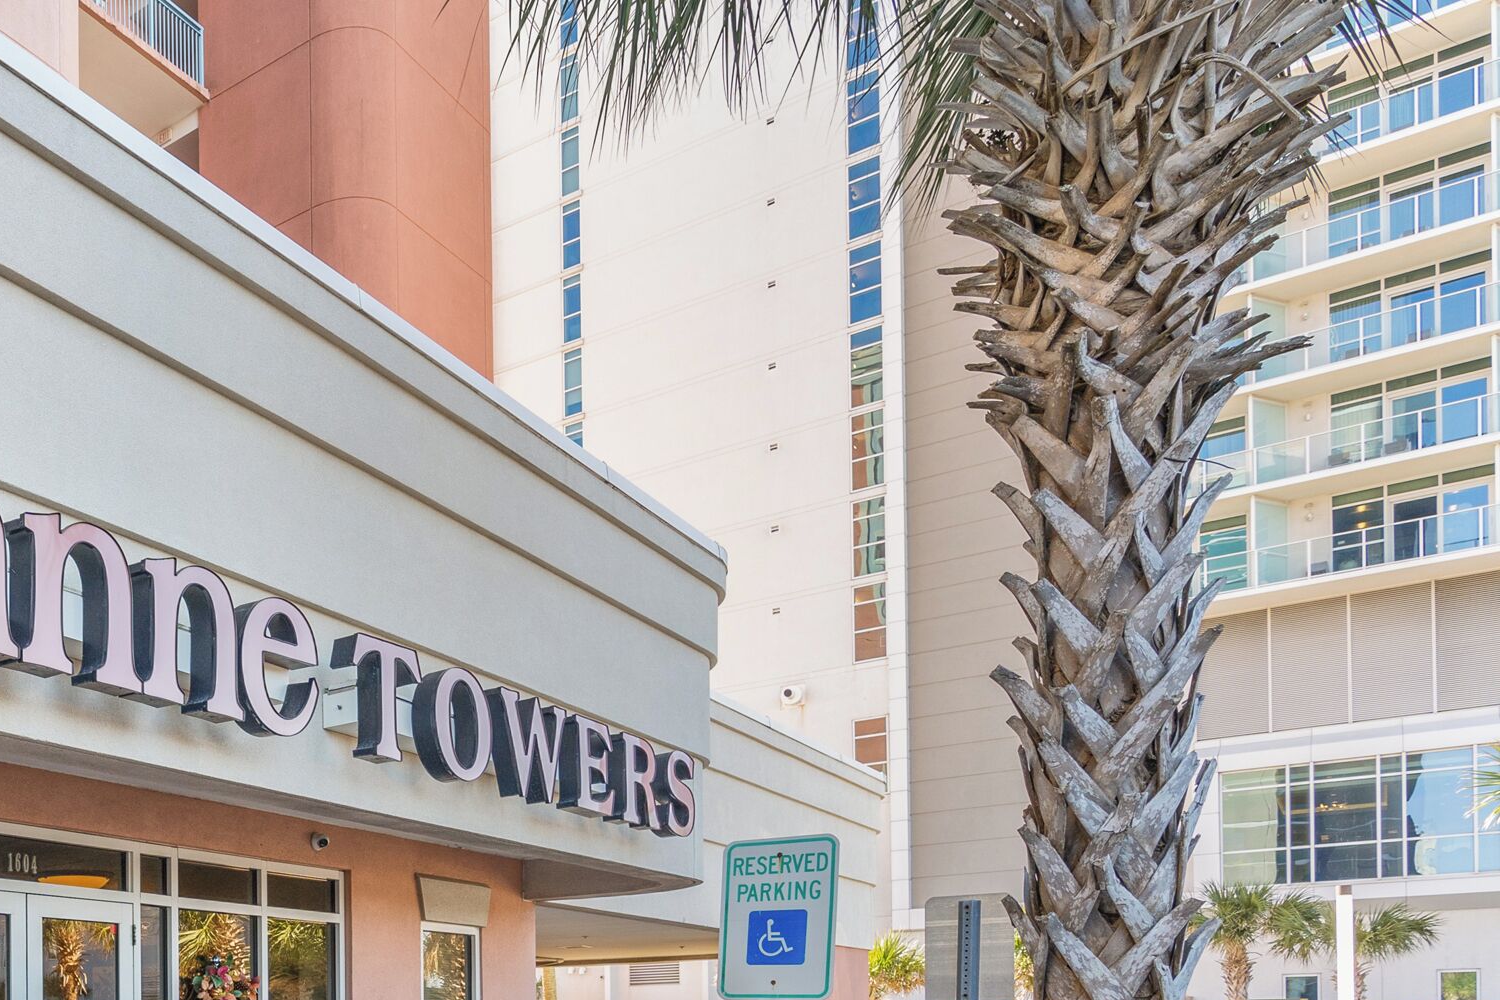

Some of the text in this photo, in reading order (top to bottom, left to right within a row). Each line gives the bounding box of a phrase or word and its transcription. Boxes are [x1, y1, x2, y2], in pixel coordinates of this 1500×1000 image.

[331, 631, 695, 838] TOWERS
[7, 853, 38, 874] 1604
[733, 852, 828, 876] RESERVED
[737, 880, 821, 902] PARKING
